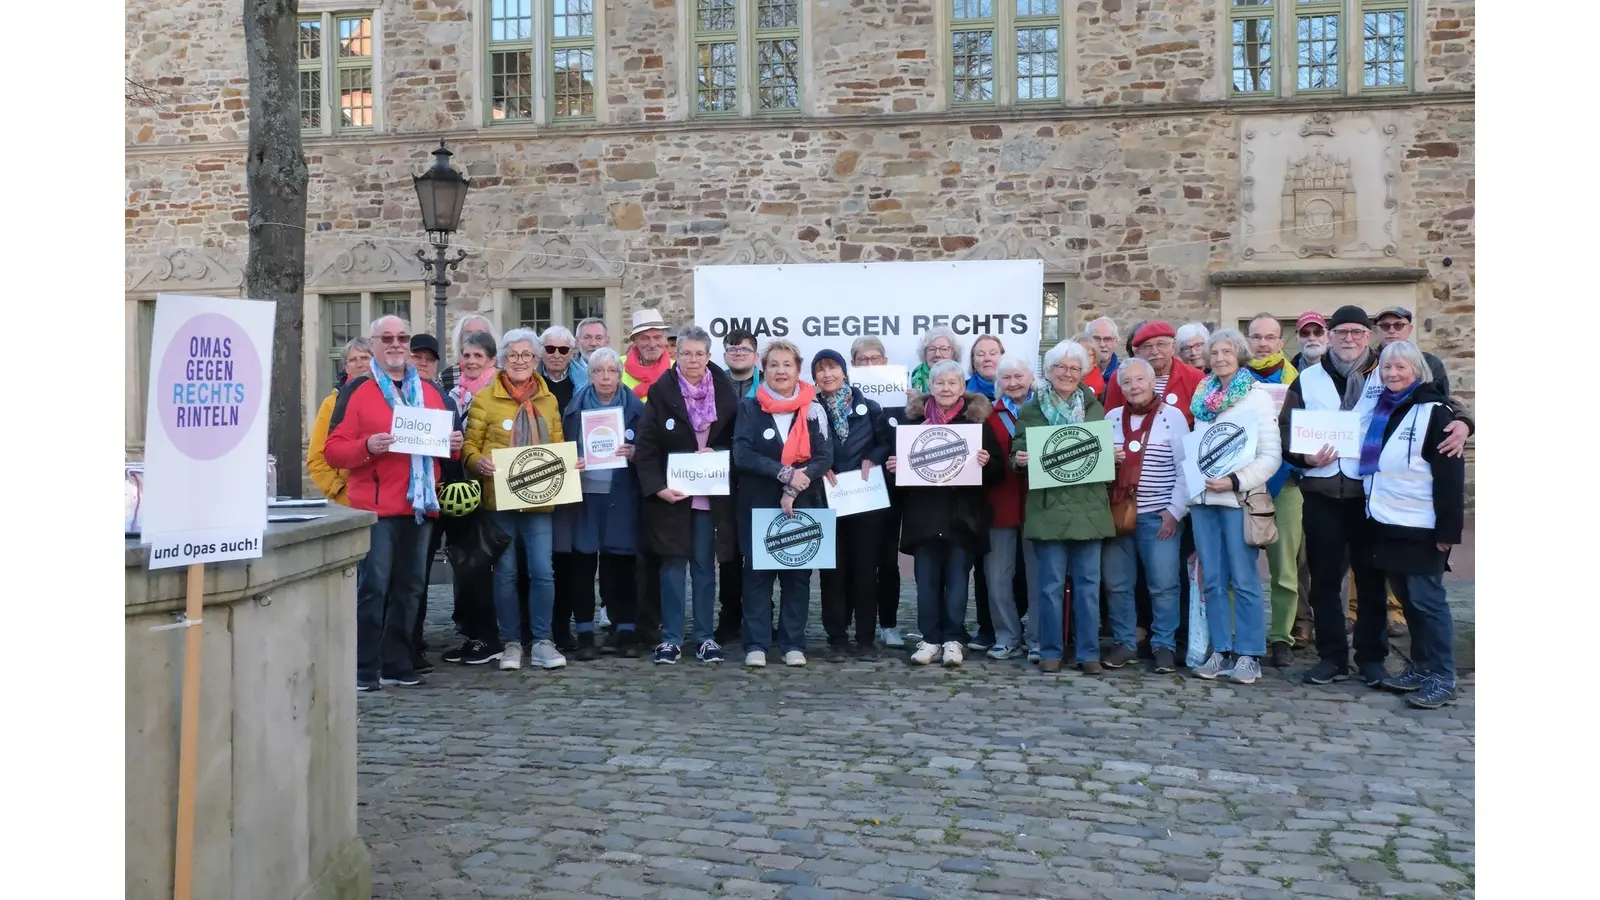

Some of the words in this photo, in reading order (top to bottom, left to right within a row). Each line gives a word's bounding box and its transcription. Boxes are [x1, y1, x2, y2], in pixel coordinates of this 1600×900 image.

[708, 315, 790, 338] OMAS
[801, 315, 900, 337] GEGEN
[912, 313, 1029, 335] RECHTS
[189, 336, 232, 358] OMAS
[186, 360, 234, 381] GEGEN
[173, 383, 246, 405] RECHTS
[852, 381, 905, 396] Respekt
[176, 405, 239, 428] RINTELN
[394, 416, 432, 434] Dialog
[393, 432, 448, 448] bereitschaft
[921, 431, 948, 445] ZUSAMMEN
[1051, 430, 1080, 445] ZUSAMMEN
[1204, 426, 1228, 446] ZUSAMMEN
[1294, 426, 1355, 441] Toleranz
[517, 451, 544, 467] ZUSAMMEN
[924, 444, 966, 461] MENSCHENWÜRDE
[1043, 457, 1057, 467] 100%
[1057, 441, 1098, 461] MENSCHENWÜRDE
[509, 477, 524, 488] 100%
[523, 463, 563, 483] MENSCHENWÜRDE
[921, 468, 937, 479] GEGEN
[1054, 469, 1071, 479] GEGEN
[1072, 456, 1095, 479] RASSISMUS
[521, 490, 538, 500] GEGEN
[539, 477, 560, 500] RASSISMUS
[775, 515, 803, 528] ZUSAMMEN
[154, 544, 180, 560] und
[183, 543, 217, 558] Opas
[220, 538, 258, 552] auch!
[766, 539, 781, 549] 100%
[780, 528, 820, 545] MENSCHENWÜRDE
[777, 551, 793, 562] GEGEN
[794, 541, 817, 563] RASSISMUS
